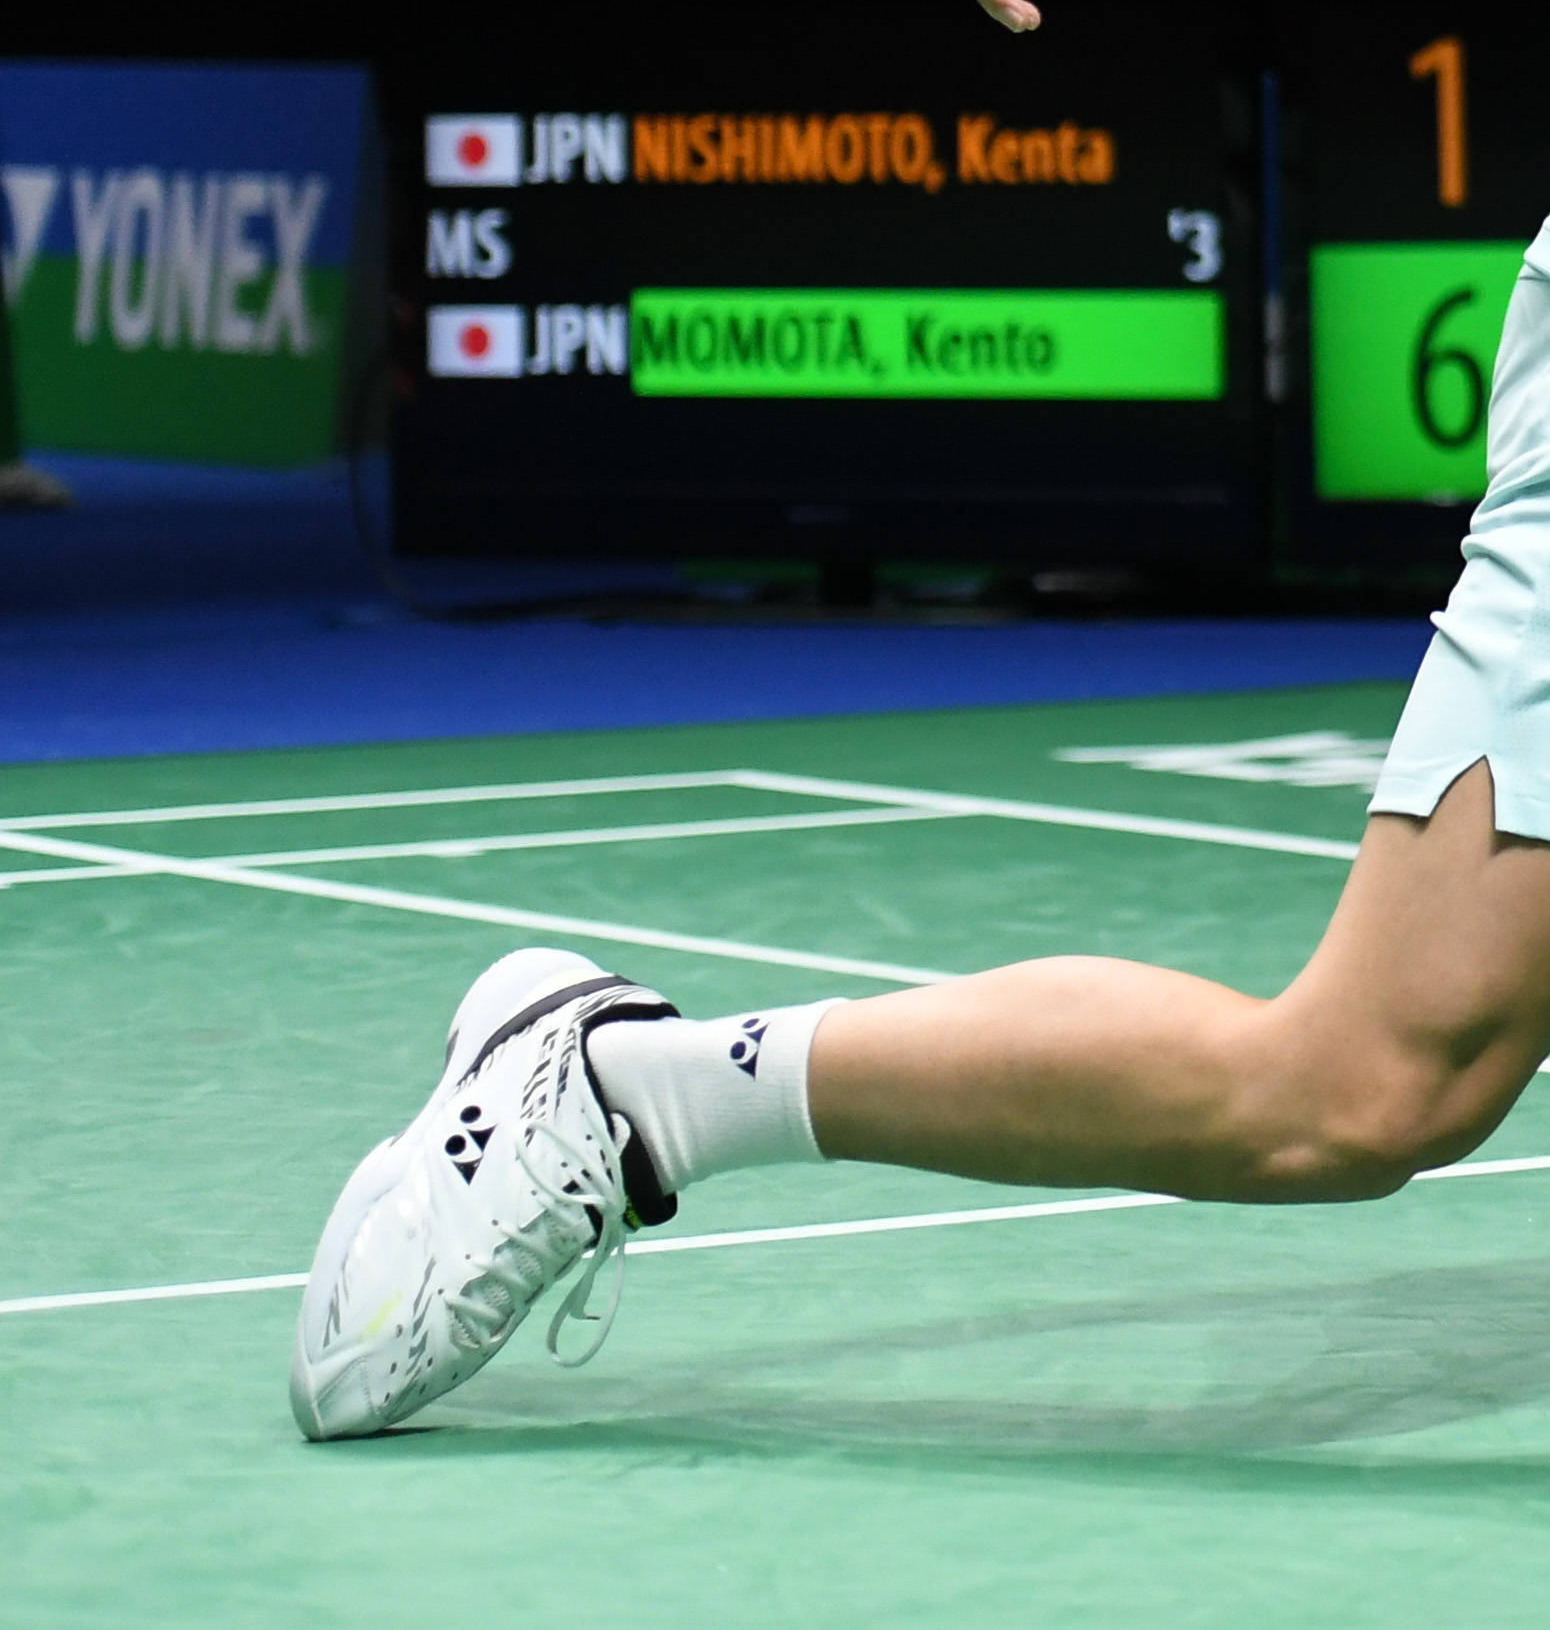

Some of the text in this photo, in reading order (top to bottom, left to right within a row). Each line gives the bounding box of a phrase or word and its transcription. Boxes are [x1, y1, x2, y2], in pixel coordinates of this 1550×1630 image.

[524, 113, 1116, 194] JPN NISHIMOTO, Kenta
[1409, 34, 1467, 209] 1
[72, 167, 328, 357] YONEX
[425, 208, 512, 279] MS
[524, 304, 1060, 382] JPN MOMOTA, Kento
[1411, 285, 1484, 453] 6
